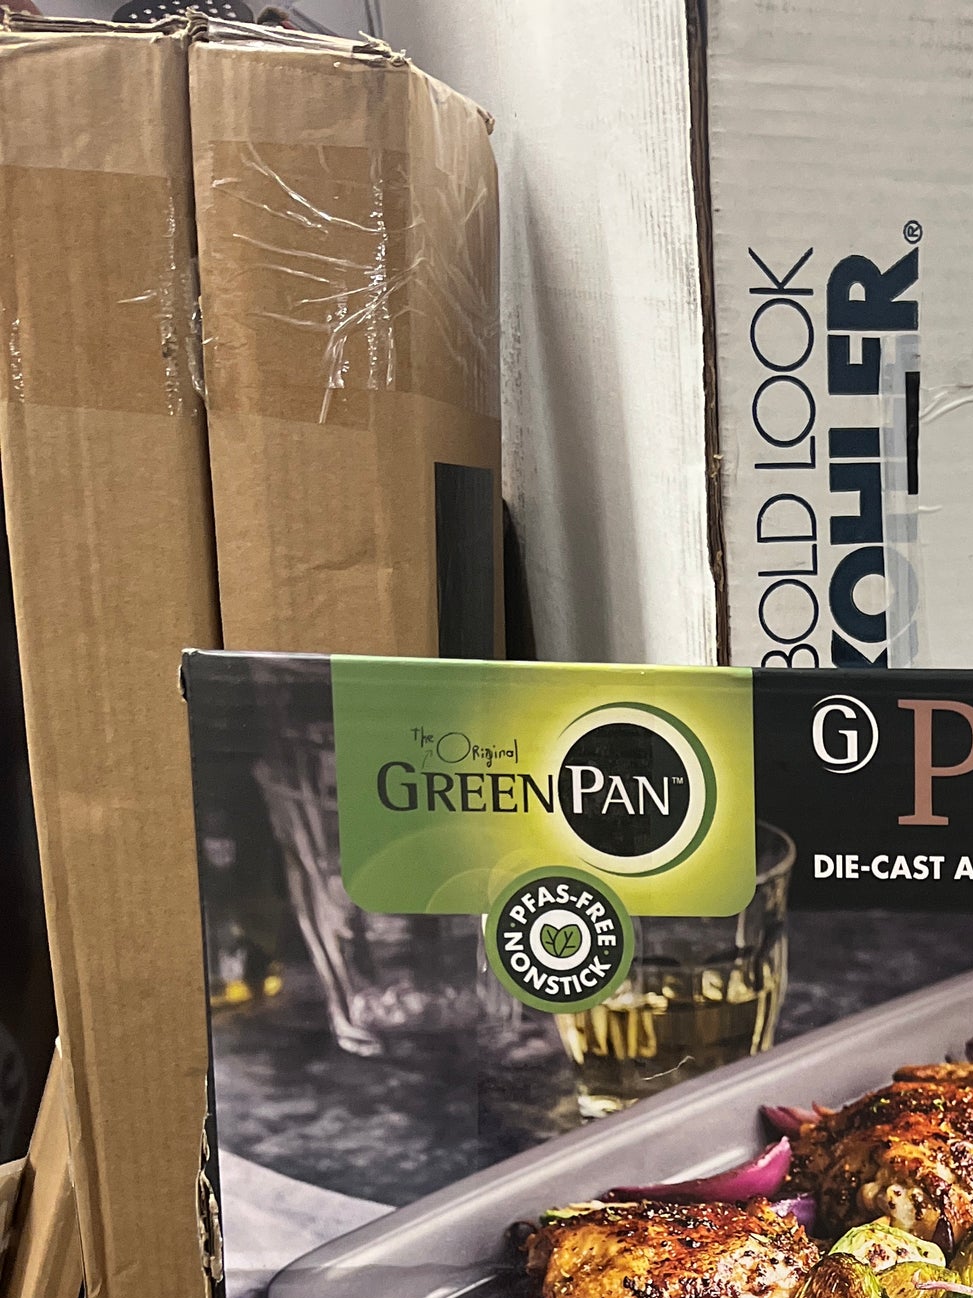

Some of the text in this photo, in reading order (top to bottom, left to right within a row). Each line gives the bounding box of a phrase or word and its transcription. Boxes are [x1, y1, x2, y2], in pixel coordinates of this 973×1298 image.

[748, 247, 817, 470] LOOK
[411, 727, 434, 745] The
[813, 855, 945, 880] DIE-CAST
[509, 884, 617, 947] PFAS-FREE
[504, 932, 612, 995] NONSTICK
